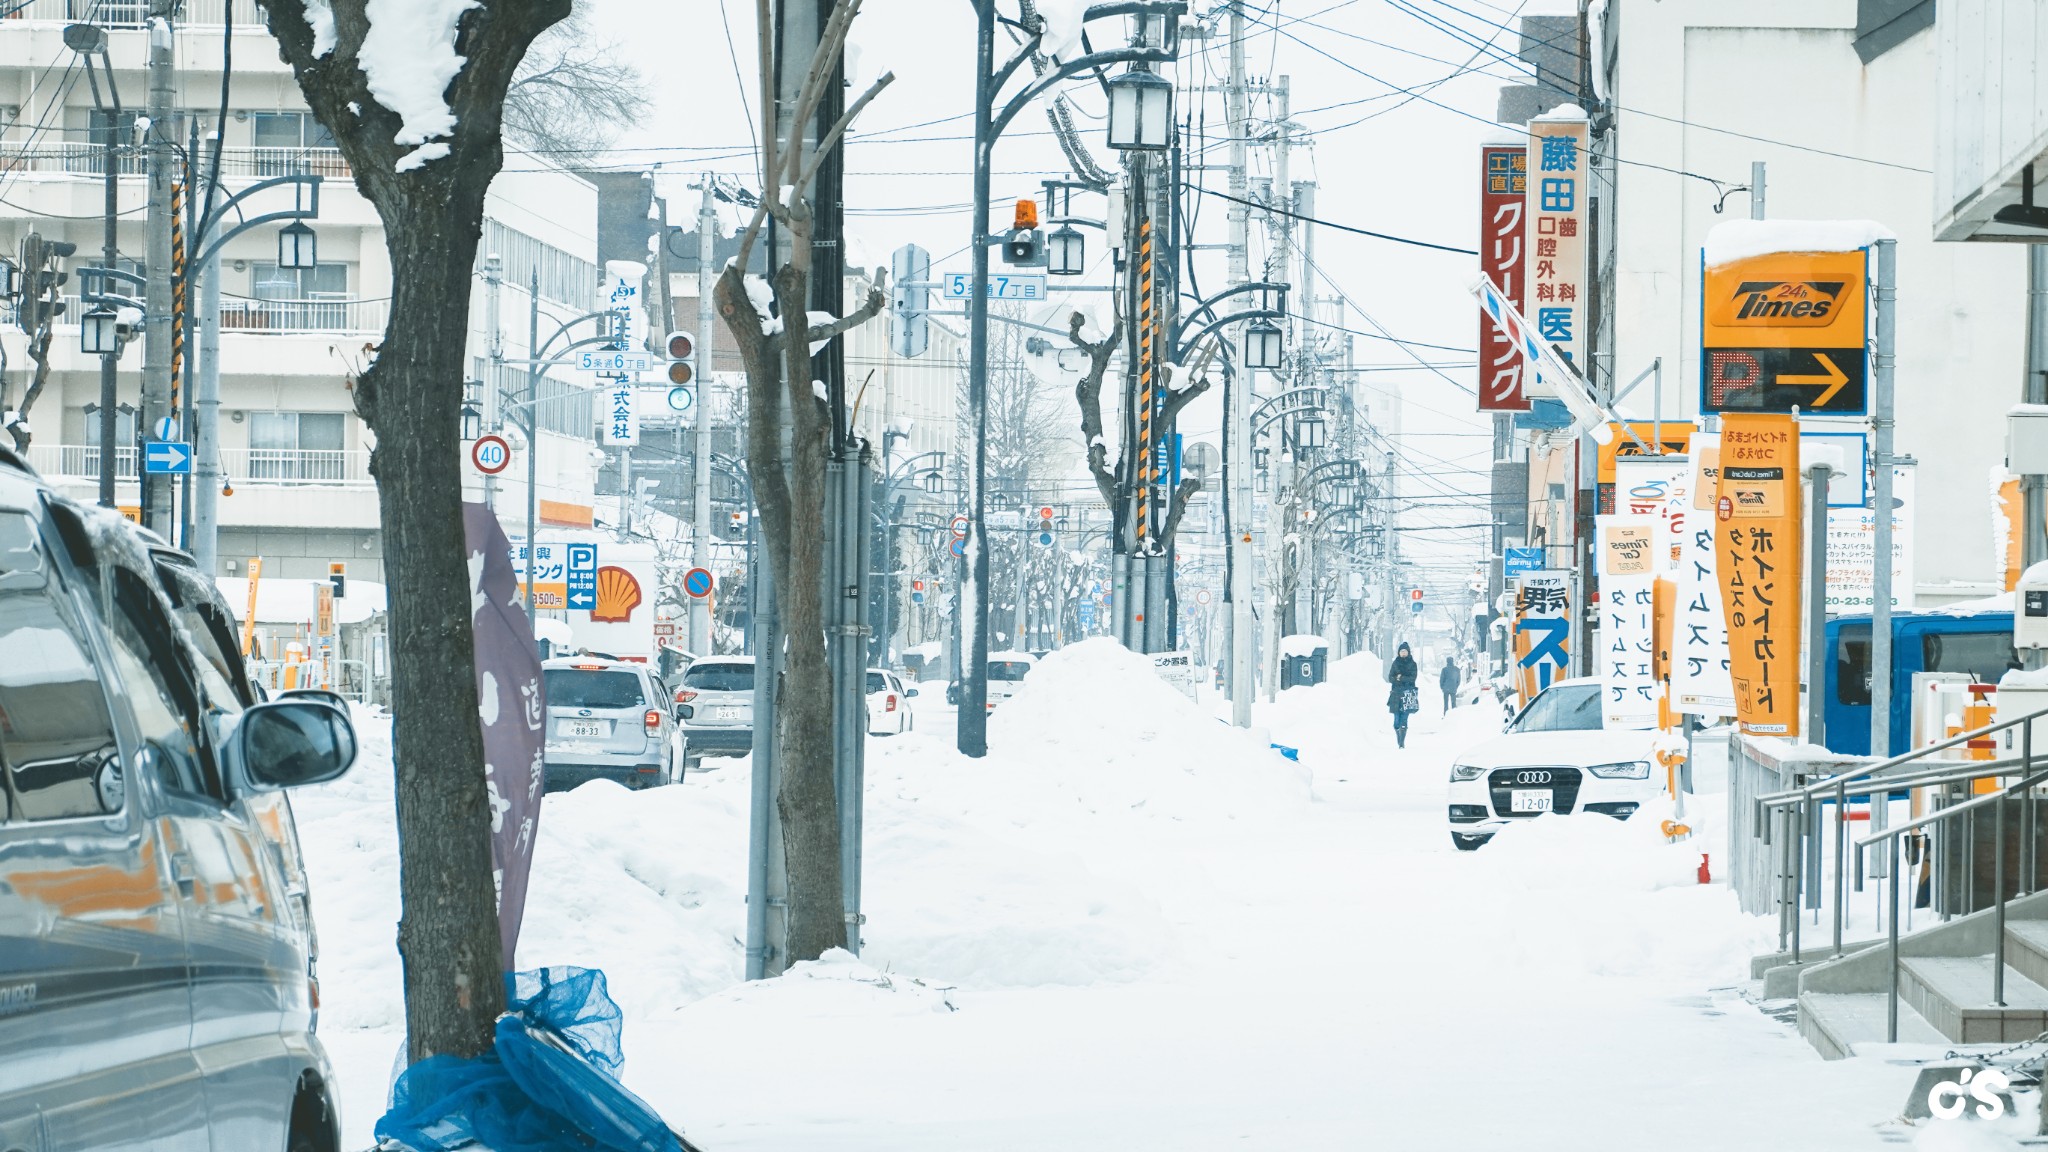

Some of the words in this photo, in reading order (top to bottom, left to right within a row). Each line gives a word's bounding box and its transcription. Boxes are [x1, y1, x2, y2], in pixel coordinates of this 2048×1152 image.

[1490, 155, 1526, 172] 工場
[1540, 134, 1578, 212] 藤田
[1490, 176, 1526, 193] 直営
[1736, 292, 1832, 320] Times
[583, 353, 646, 370] 5条通6丁目
[481, 446, 501, 463] 40
[1516, 587, 1569, 617] 男気
[1825, 596, 1899, 606] 20-23-83
[1154, 656, 1188, 667] ごみ置場
[575, 727, 599, 736] 88-33
